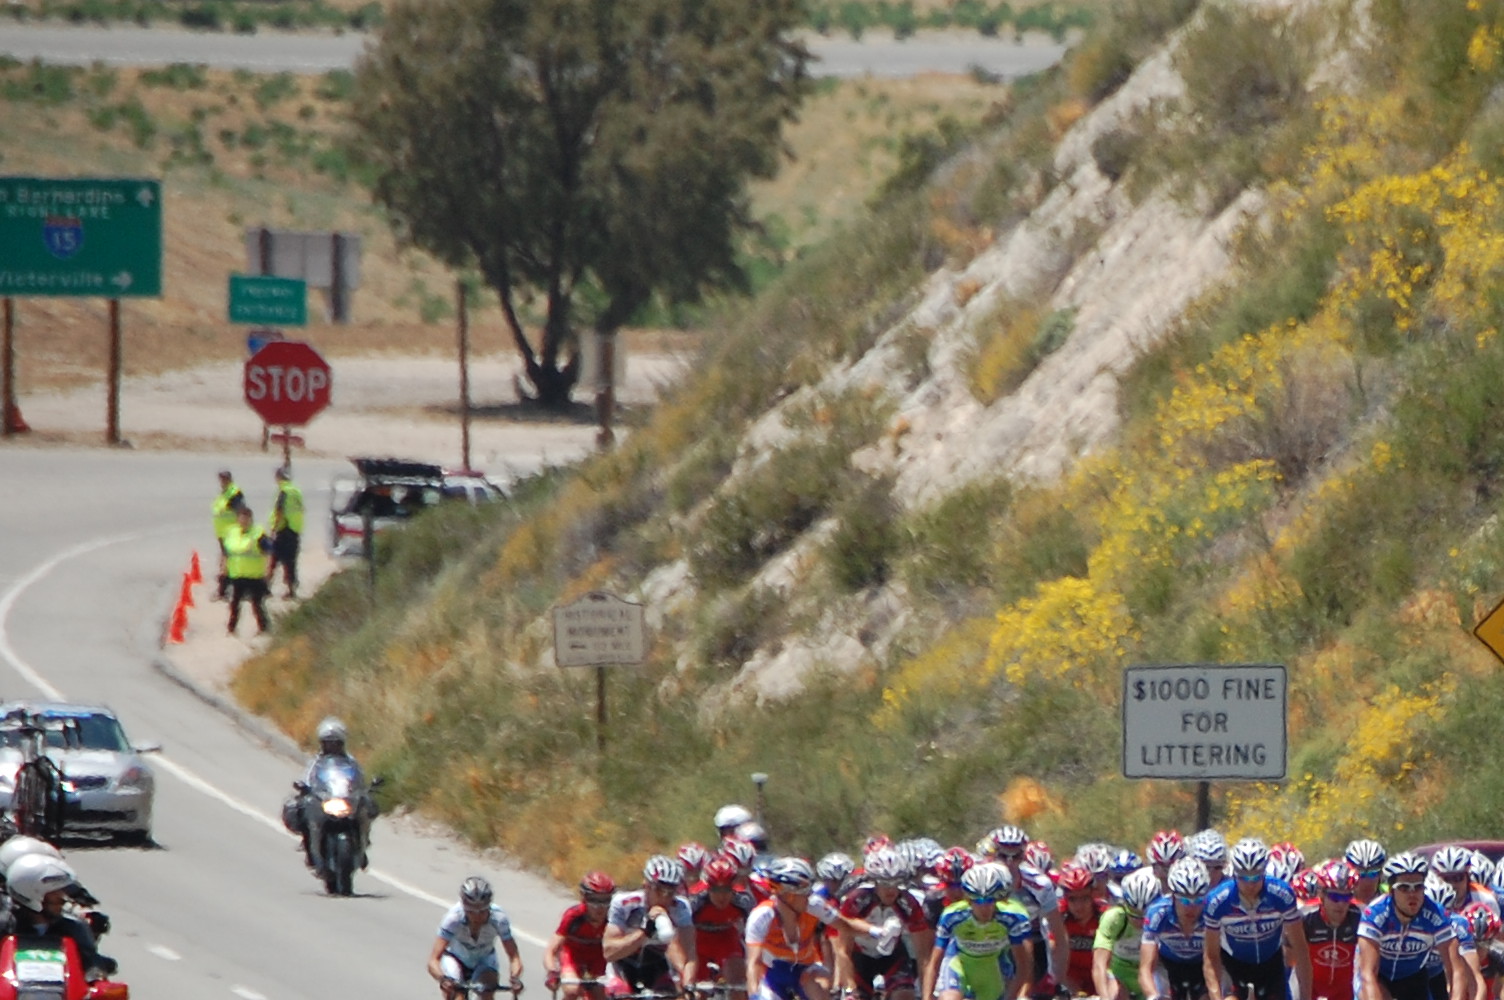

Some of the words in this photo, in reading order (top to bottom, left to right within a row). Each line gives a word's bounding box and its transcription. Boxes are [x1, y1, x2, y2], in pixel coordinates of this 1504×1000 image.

[53, 231, 77, 250] 15
[248, 366, 327, 402] STOP
[1133, 677, 1210, 701] $1000
[1223, 678, 1276, 700] FINE
[1181, 711, 1229, 733] FOR
[1141, 744, 1267, 766] LITTERING
